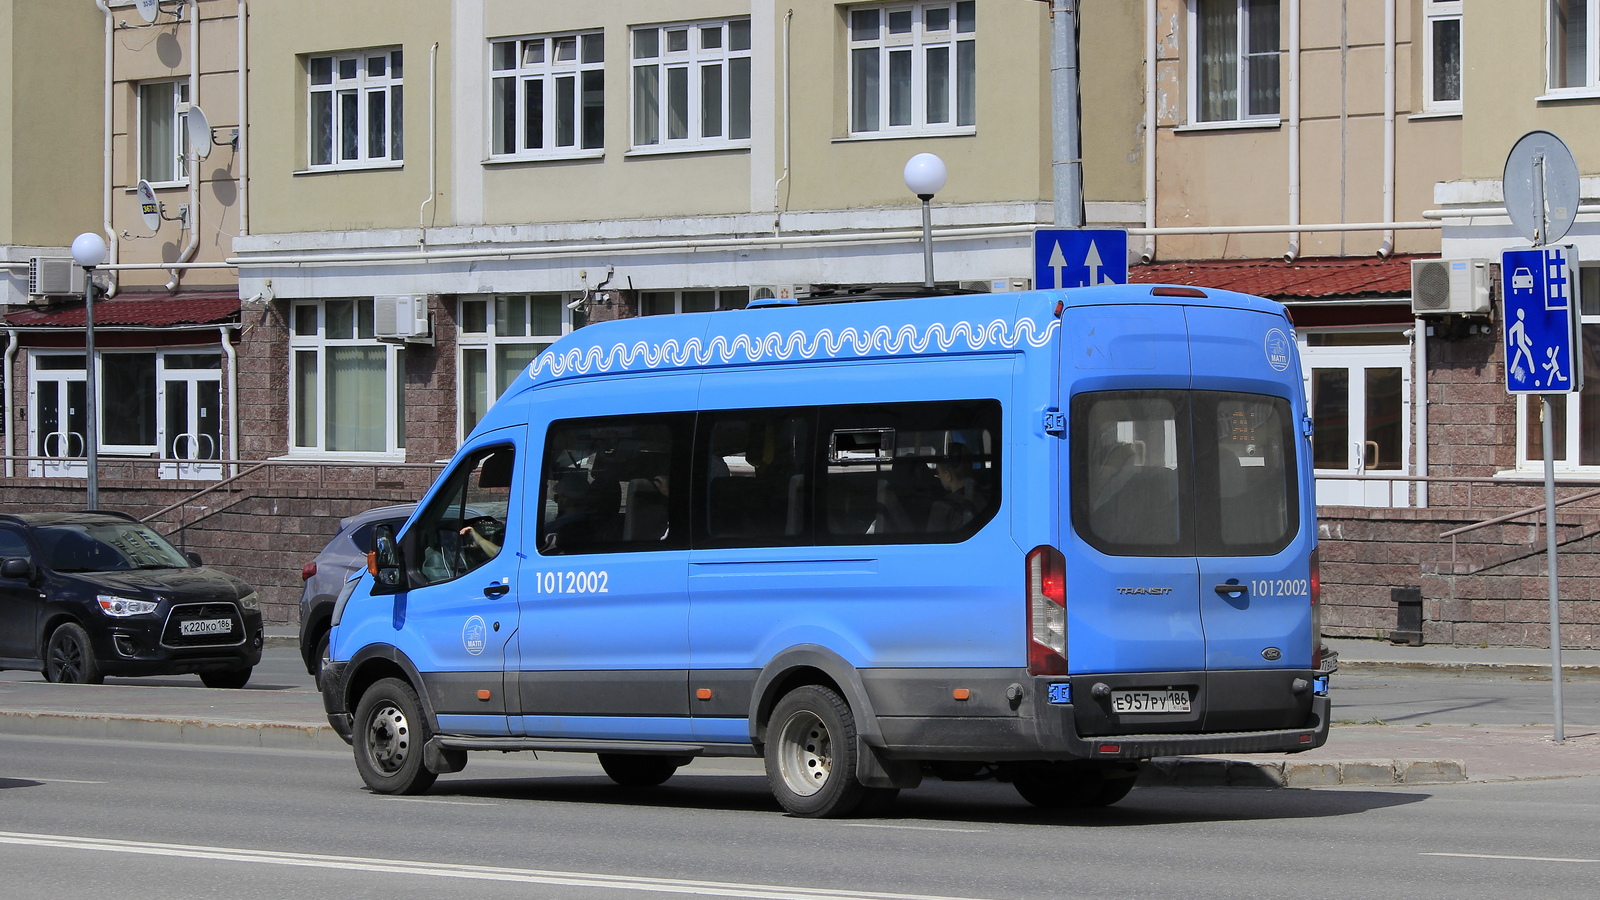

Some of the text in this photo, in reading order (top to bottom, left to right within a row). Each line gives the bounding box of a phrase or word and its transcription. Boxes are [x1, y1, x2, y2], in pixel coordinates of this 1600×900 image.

[535, 570, 609, 594] 1012002
[1251, 579, 1308, 597] 1012002
[1116, 587, 1173, 595] TRANSIT
[1168, 692, 1188, 706] 186
